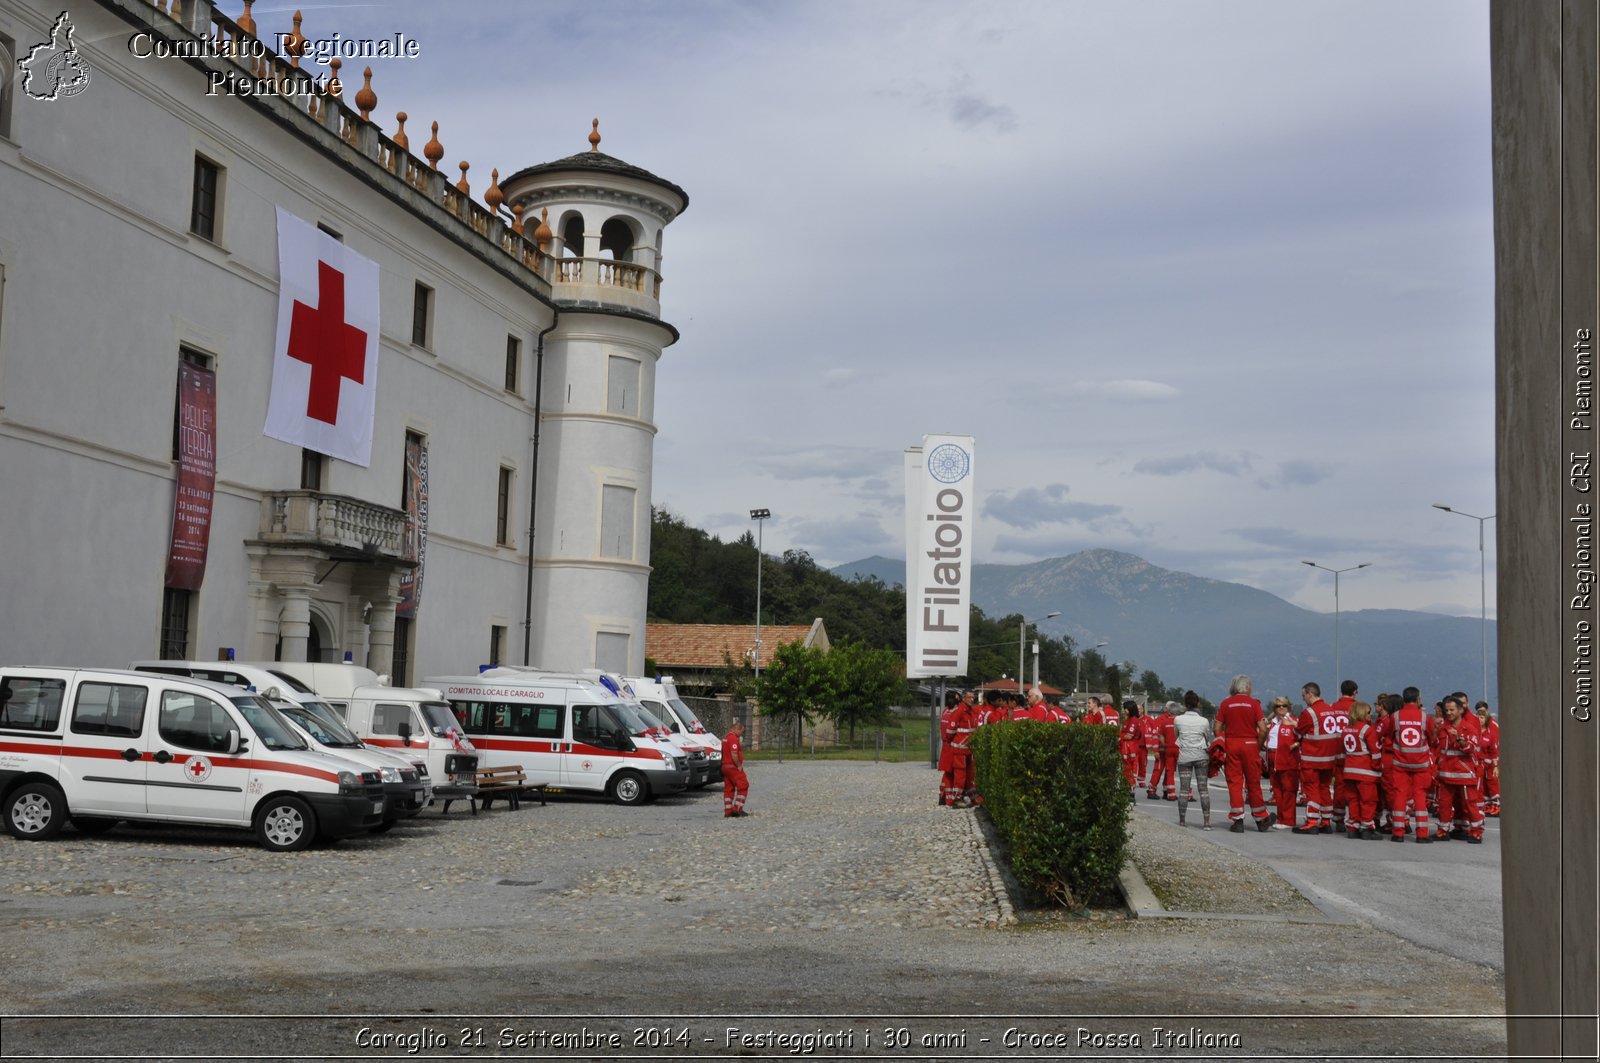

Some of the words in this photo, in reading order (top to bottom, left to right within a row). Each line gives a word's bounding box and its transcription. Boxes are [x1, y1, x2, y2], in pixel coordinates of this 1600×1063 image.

[184, 403, 208, 431] PELLE
[182, 425, 213, 460] TERRA
[922, 488, 964, 633] Filatoio
[922, 648, 958, 667] Il
[448, 686, 481, 695] COMITATO
[482, 688, 509, 697] LOCALE
[510, 689, 545, 699] CARAGLIO
